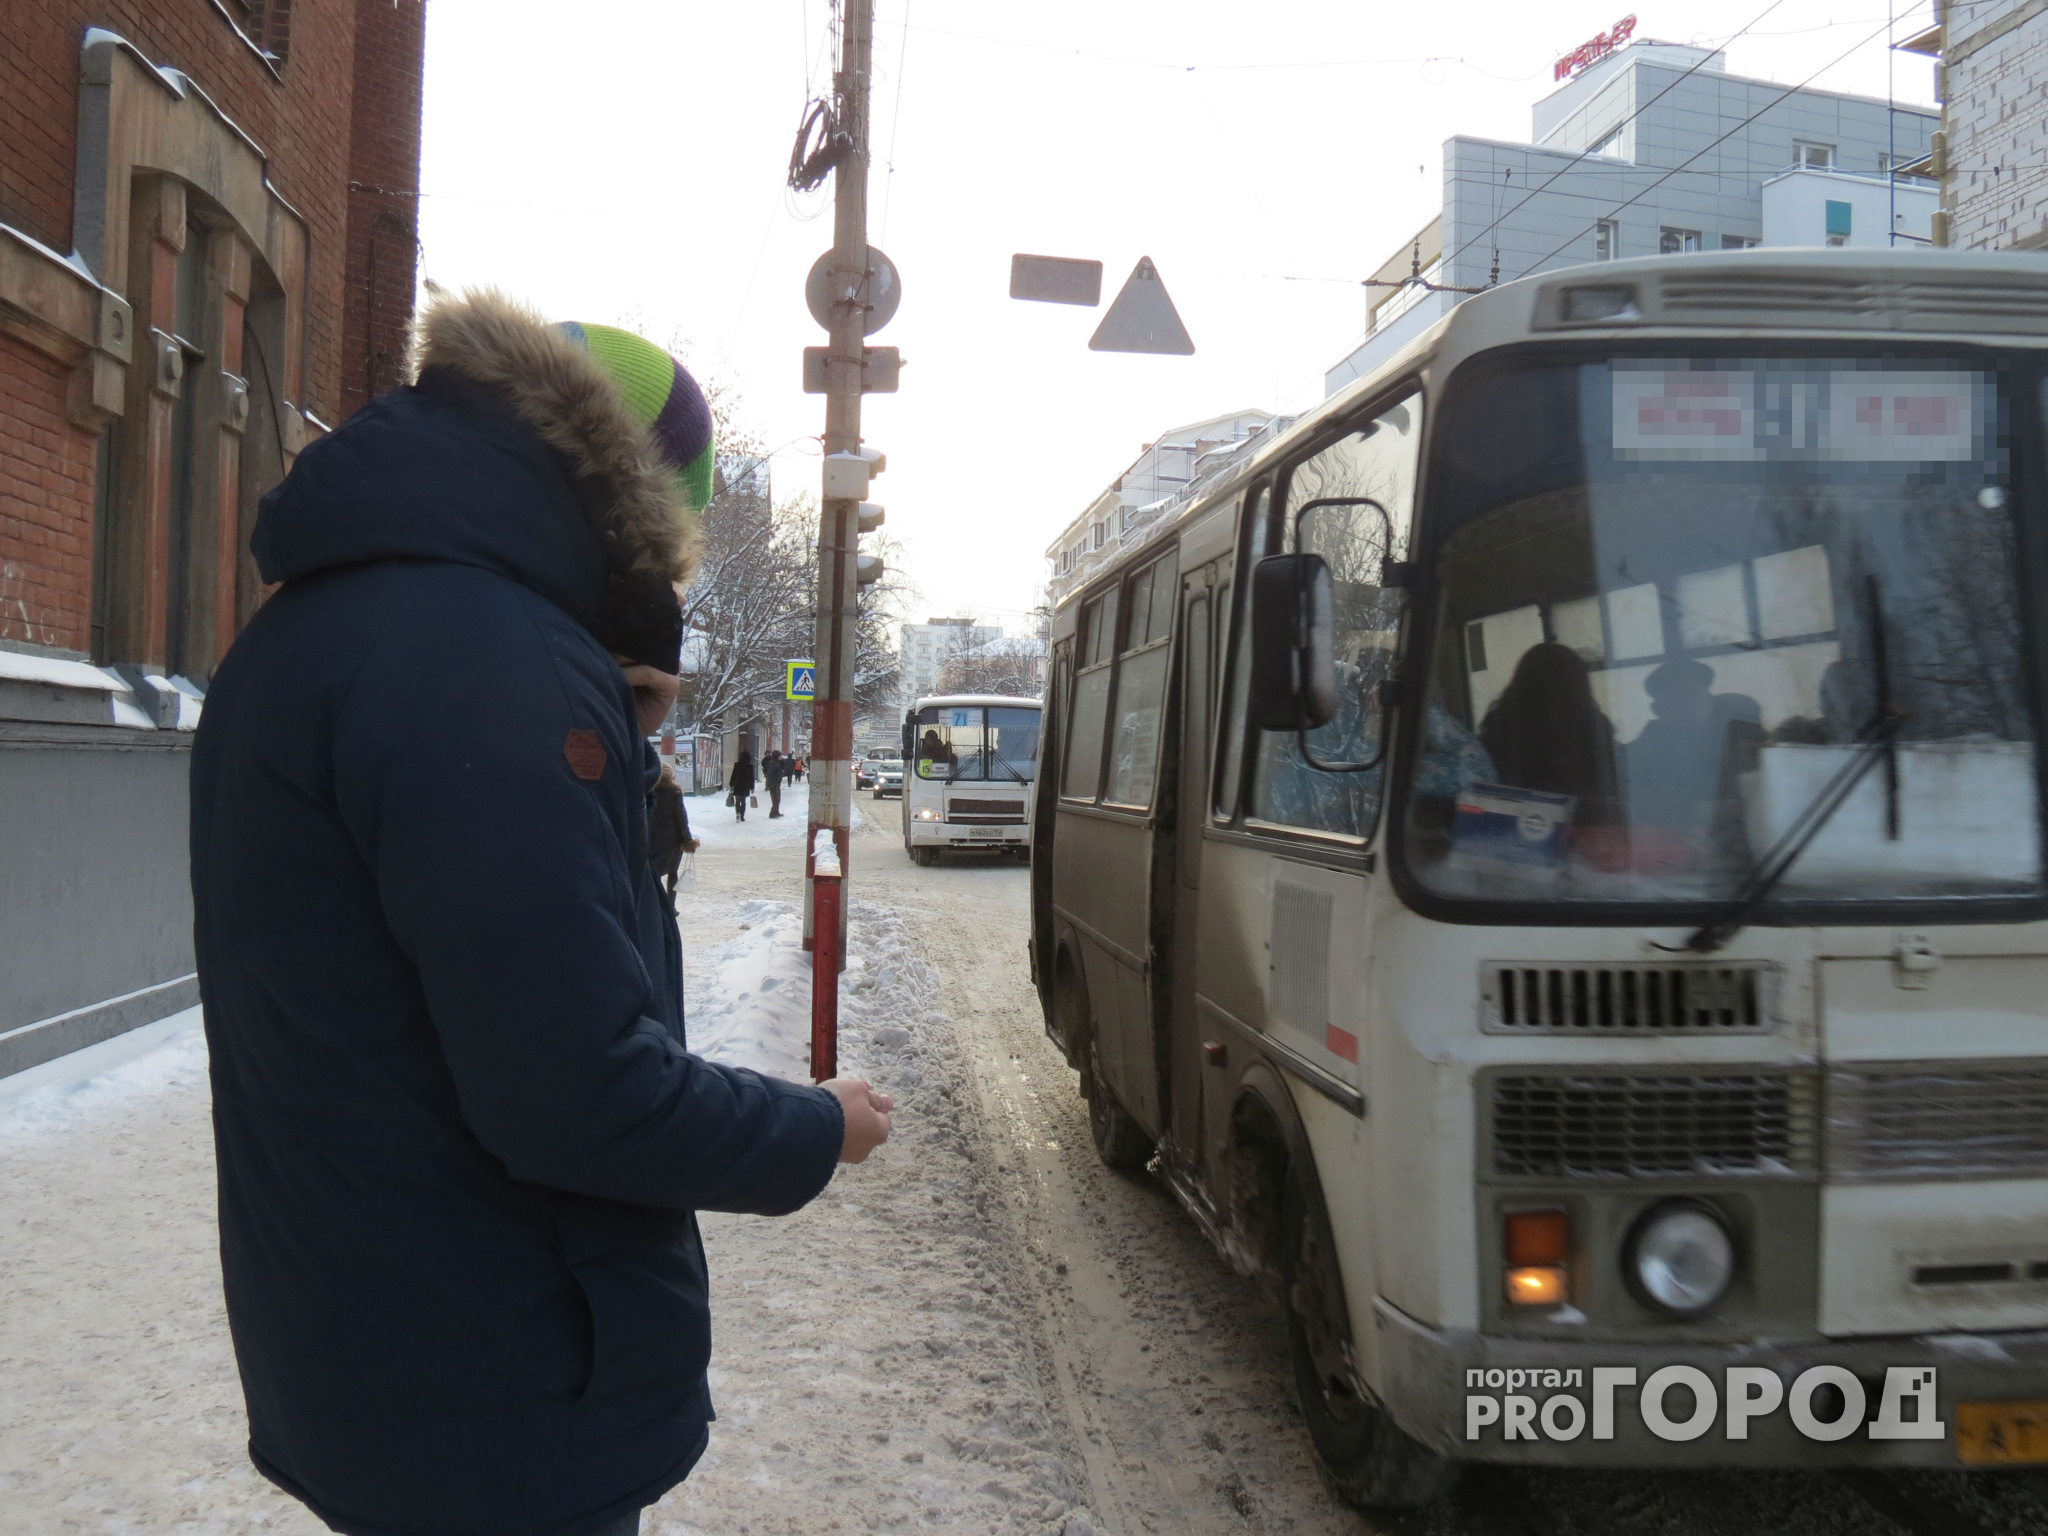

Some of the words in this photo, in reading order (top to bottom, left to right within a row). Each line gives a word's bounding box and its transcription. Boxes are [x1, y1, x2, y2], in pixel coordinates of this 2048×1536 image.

[1554, 13, 1637, 82] ПРЕМЬЕР
[954, 712, 967, 726] 71
[922, 765, 930, 774] 15
